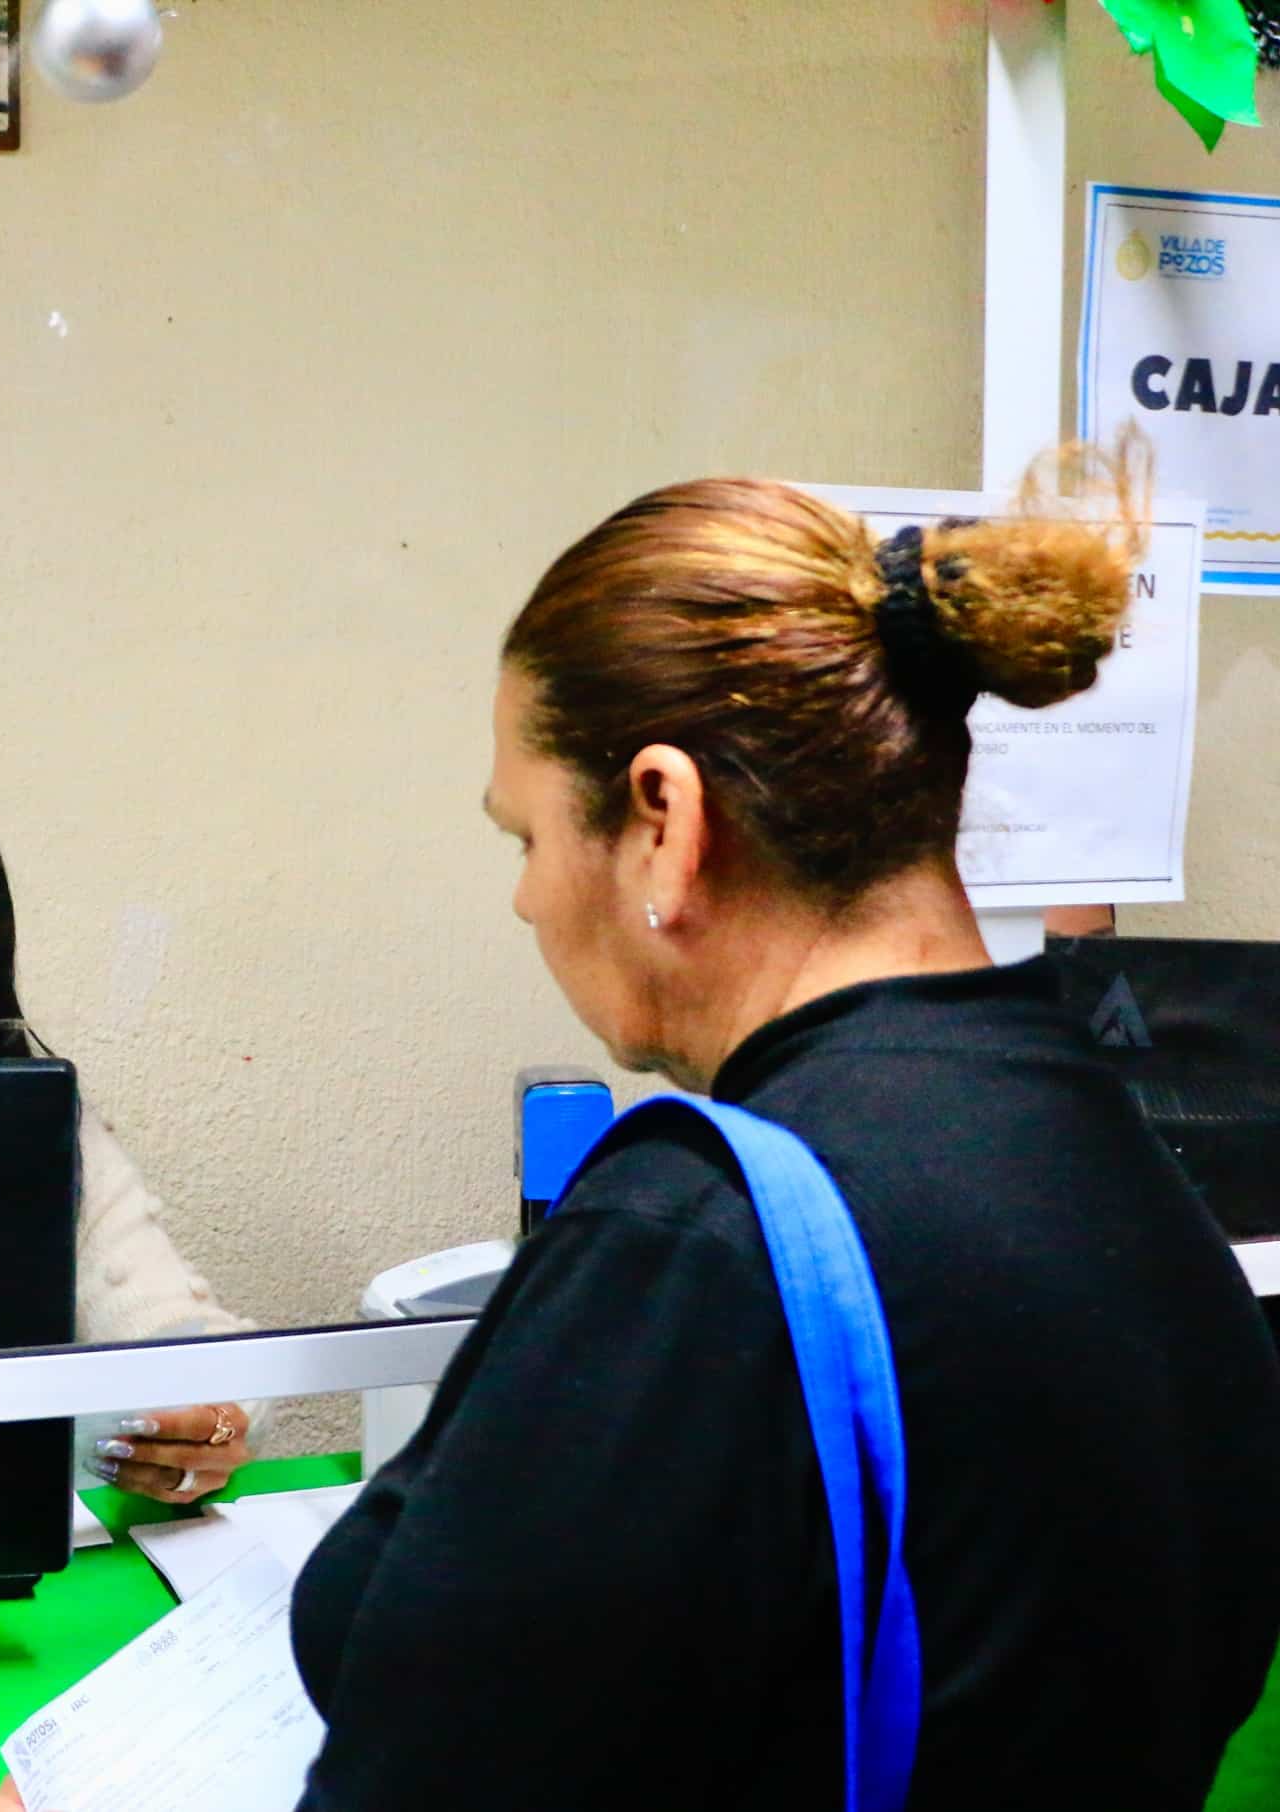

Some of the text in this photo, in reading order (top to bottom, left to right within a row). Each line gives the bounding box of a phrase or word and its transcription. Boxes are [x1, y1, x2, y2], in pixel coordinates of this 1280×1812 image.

[1160, 235, 1225, 254] VILLA DE
[1131, 354, 1280, 416] CAJA
[1119, 623, 1133, 649] E
[1044, 722, 1059, 734] EN
[1062, 722, 1073, 734] EL
[1077, 721, 1134, 735] MOMENTO
[1136, 721, 1158, 735] DEL
